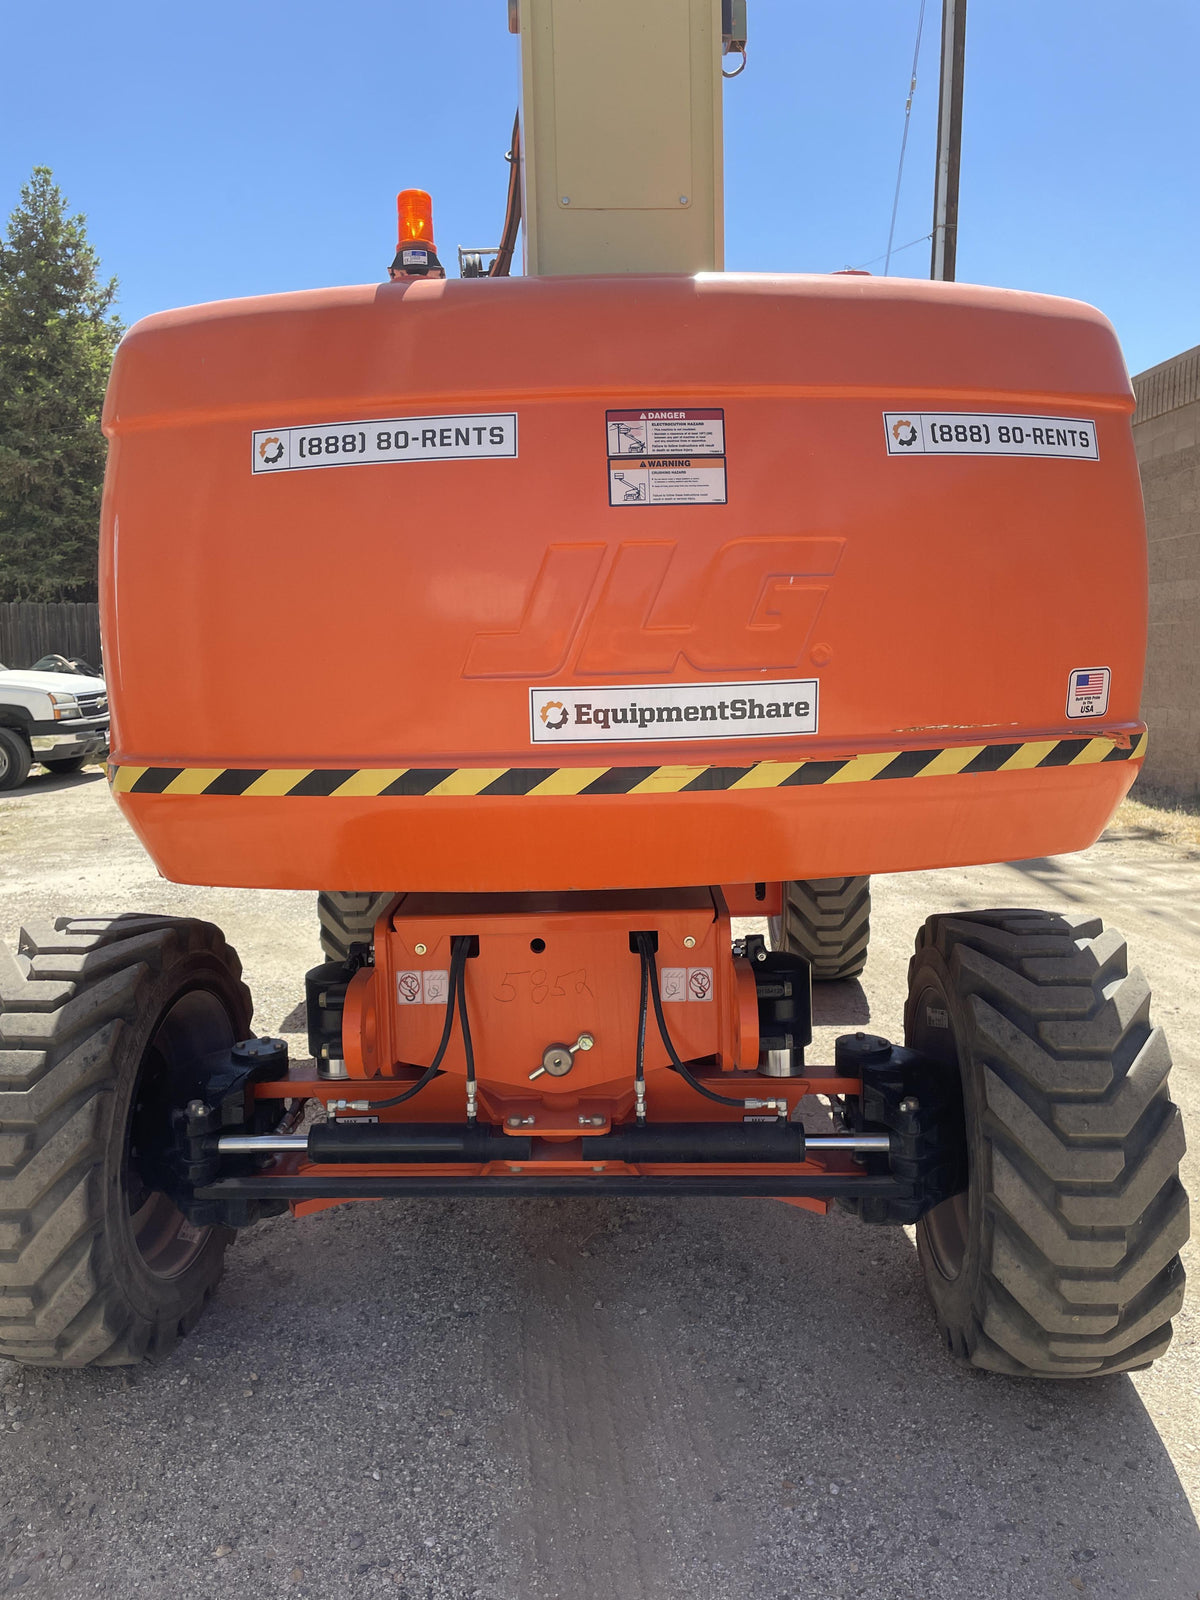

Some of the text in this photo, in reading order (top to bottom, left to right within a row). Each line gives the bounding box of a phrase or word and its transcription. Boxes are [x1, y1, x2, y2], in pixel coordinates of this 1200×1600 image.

[299, 426, 504, 458] (888) 80-RENTS
[930, 423, 1089, 447] (888) 80-RENTS
[461, 536, 847, 679] JLG
[574, 699, 810, 729] EquipmentShare
[1080, 705, 1094, 713] USA
[493, 968, 595, 1004] 5852
